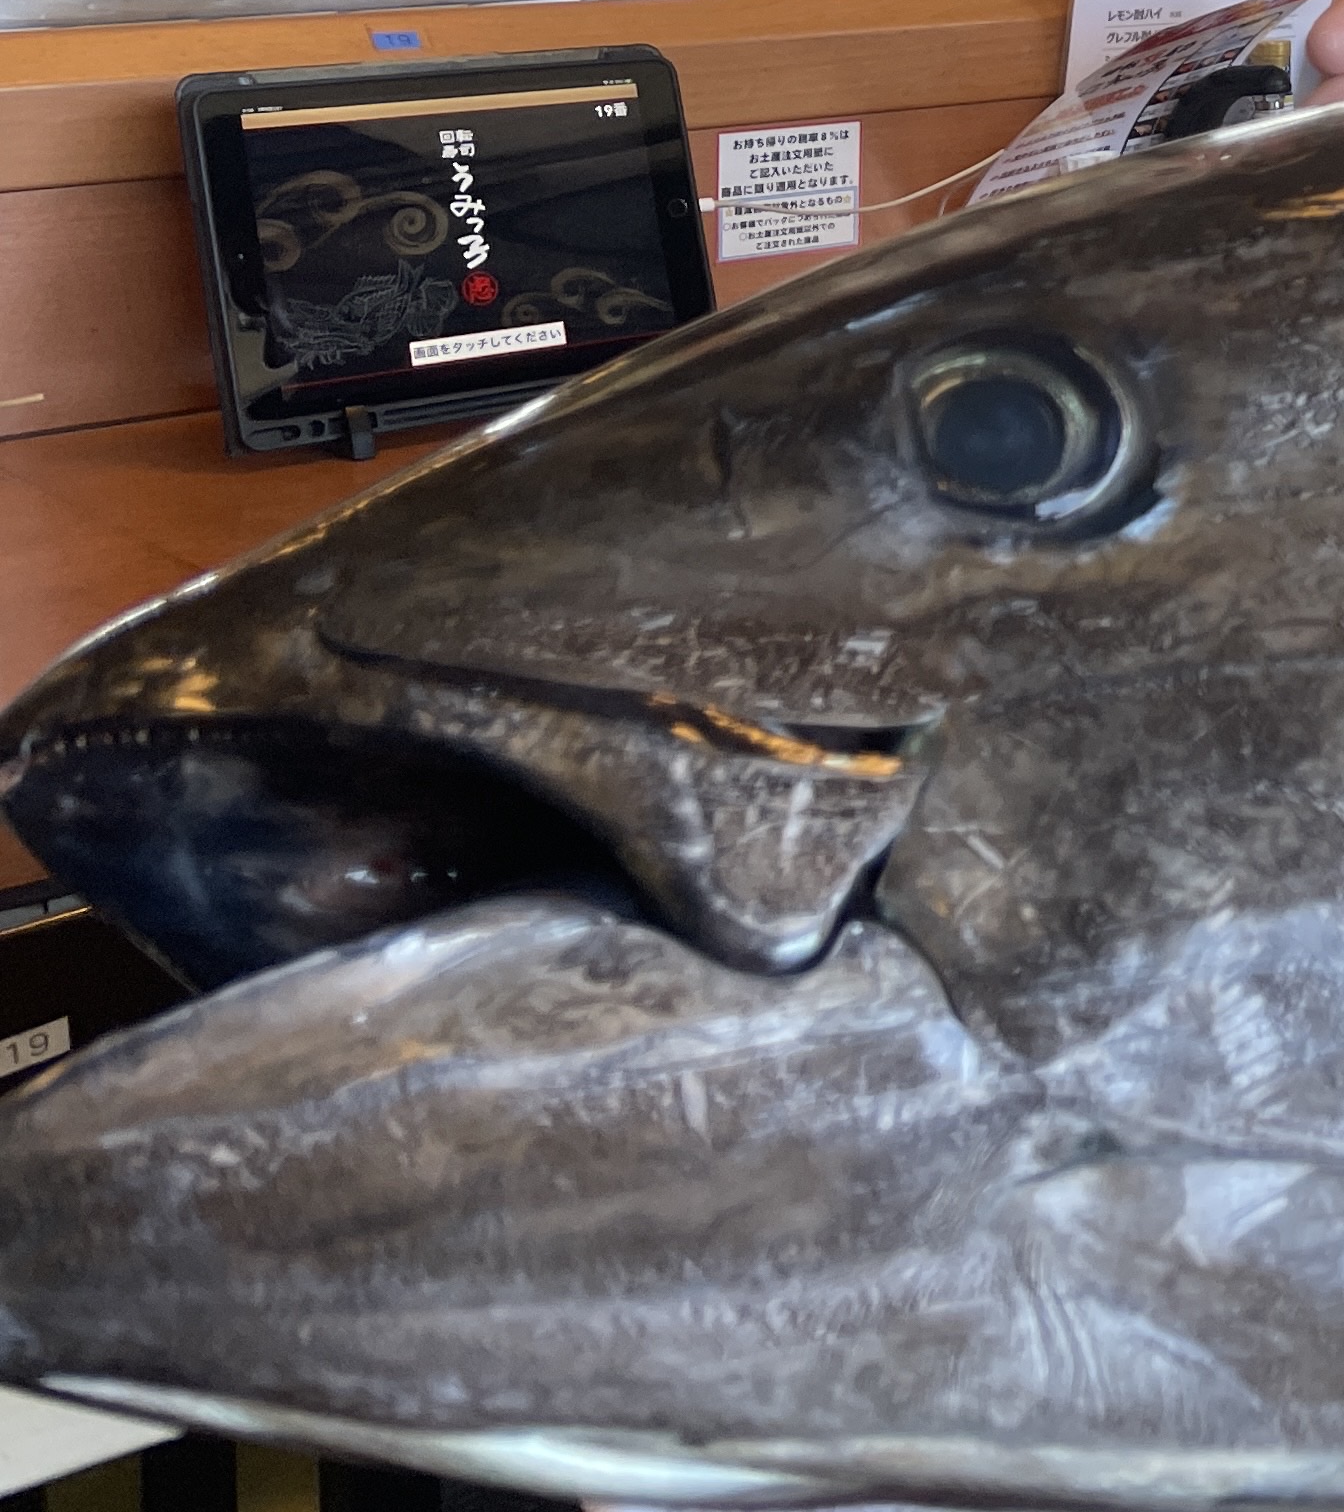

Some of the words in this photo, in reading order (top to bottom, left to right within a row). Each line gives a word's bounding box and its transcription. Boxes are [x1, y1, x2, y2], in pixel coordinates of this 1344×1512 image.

[413, 328, 562, 360] 画面をタッチしてください
[6, 1031, 49, 1065] 19
